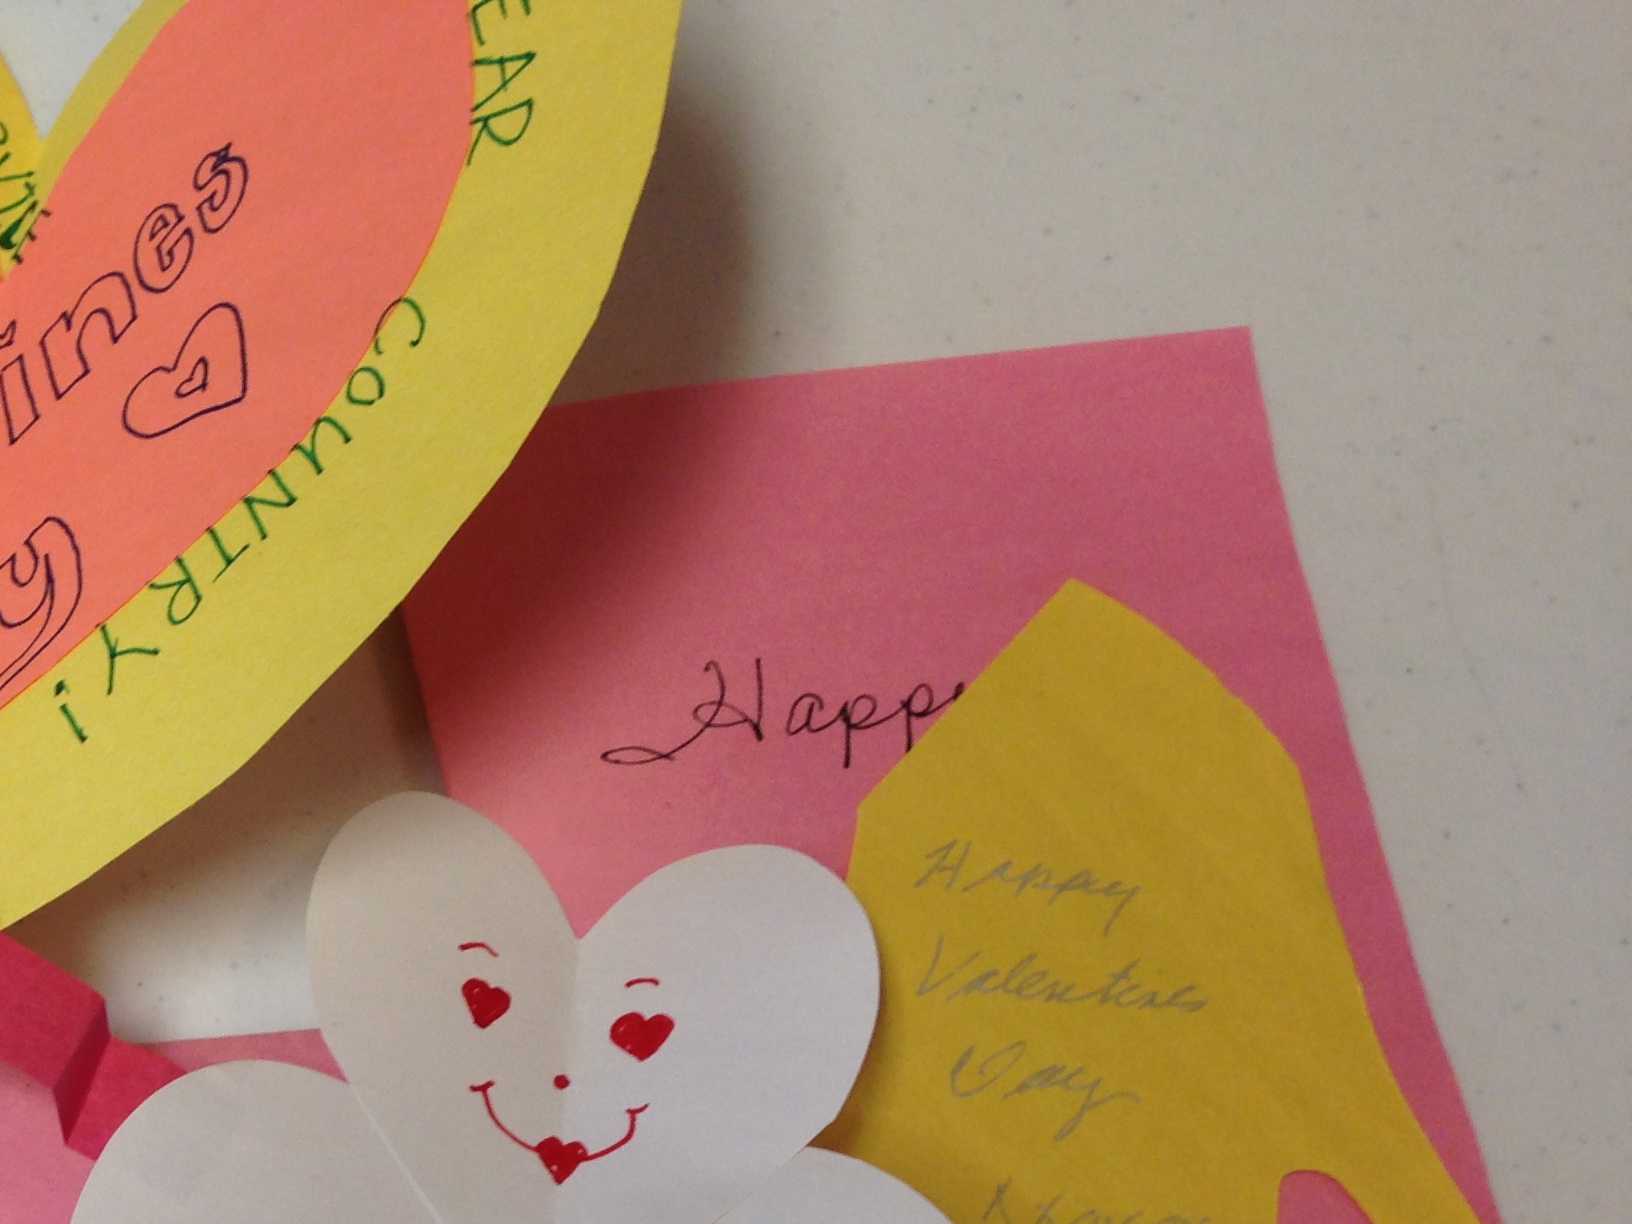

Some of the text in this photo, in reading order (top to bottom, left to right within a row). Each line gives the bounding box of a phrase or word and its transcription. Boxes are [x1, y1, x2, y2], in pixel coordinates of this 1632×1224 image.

[600, 657, 967, 770] Happ
[914, 839, 1144, 936] Happy
[949, 1041, 1143, 1142] Day
